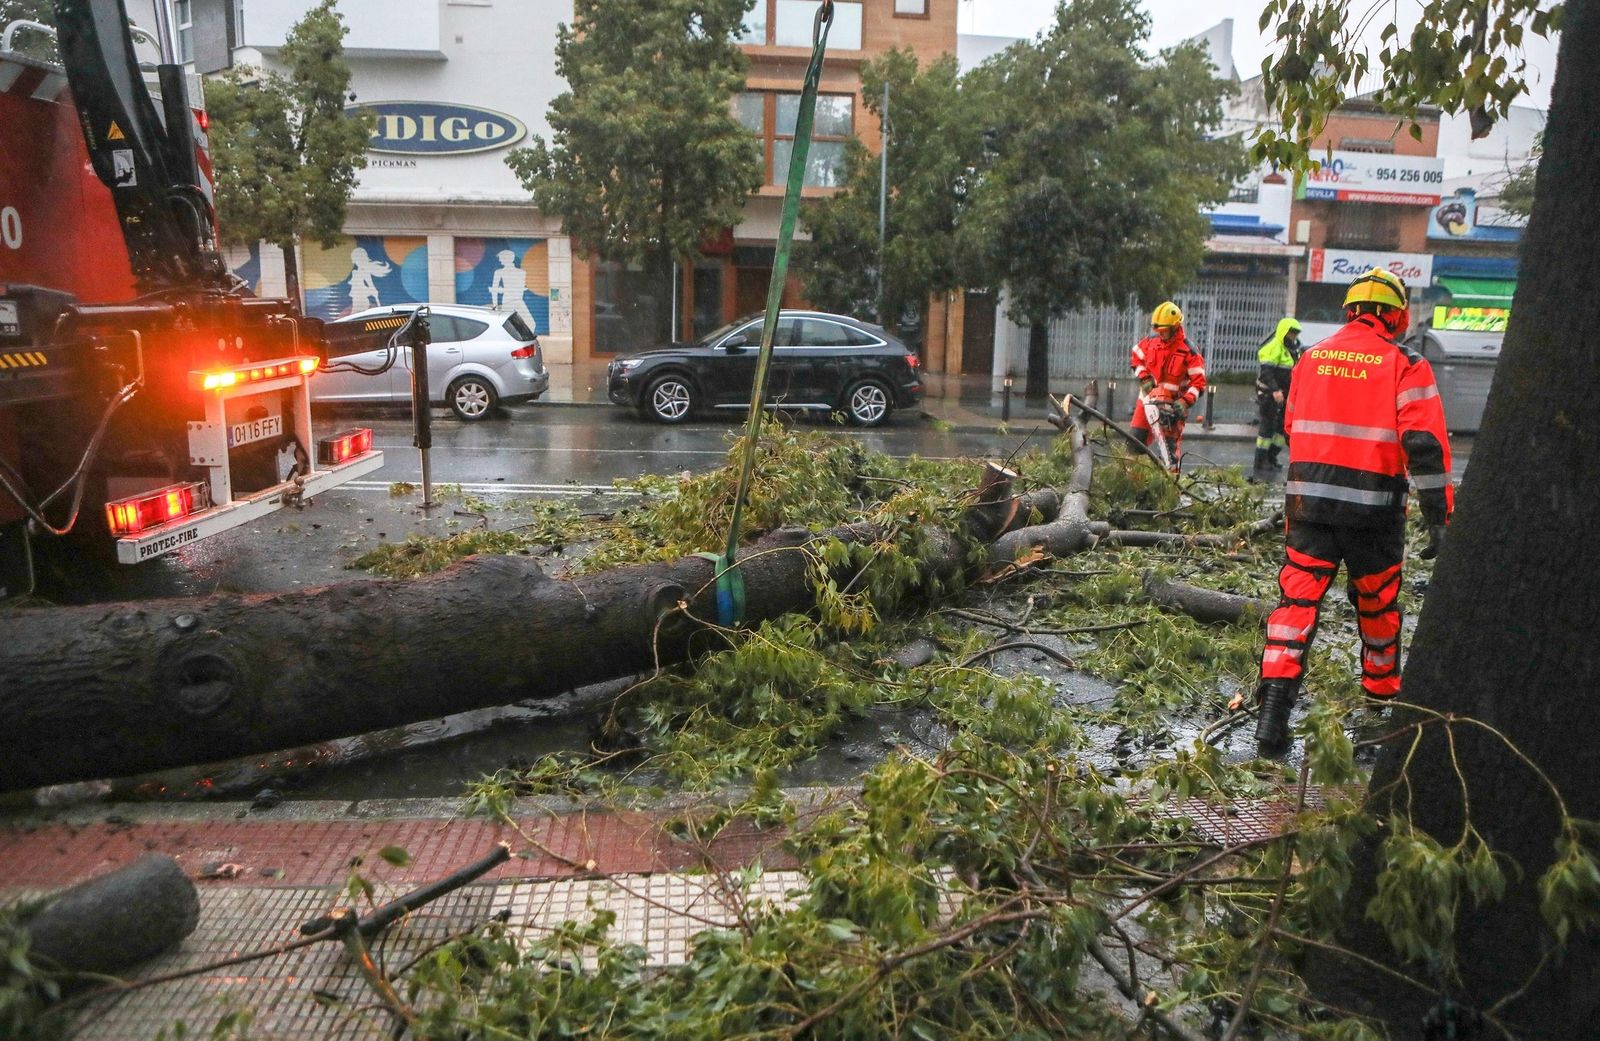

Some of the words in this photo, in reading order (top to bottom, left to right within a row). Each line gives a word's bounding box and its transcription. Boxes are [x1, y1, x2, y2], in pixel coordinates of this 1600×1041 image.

[369, 114, 505, 142] DIGO
[371, 159, 417, 167] PICKMAN
[1376, 168, 1397, 180] 954
[1400, 170, 1420, 182] 256
[1423, 171, 1443, 184] 005
[1306, 189, 1335, 199] SEVILLA
[1331, 258, 1374, 275] Rastr
[1388, 261, 1422, 278] Reto
[1311, 349, 1383, 365] BOMBEROS
[1317, 365, 1367, 379] SEVILLA
[234, 422, 260, 443] 0116
[262, 417, 280, 436] FFY
[139, 527, 199, 558] PROTEC-FIRE
